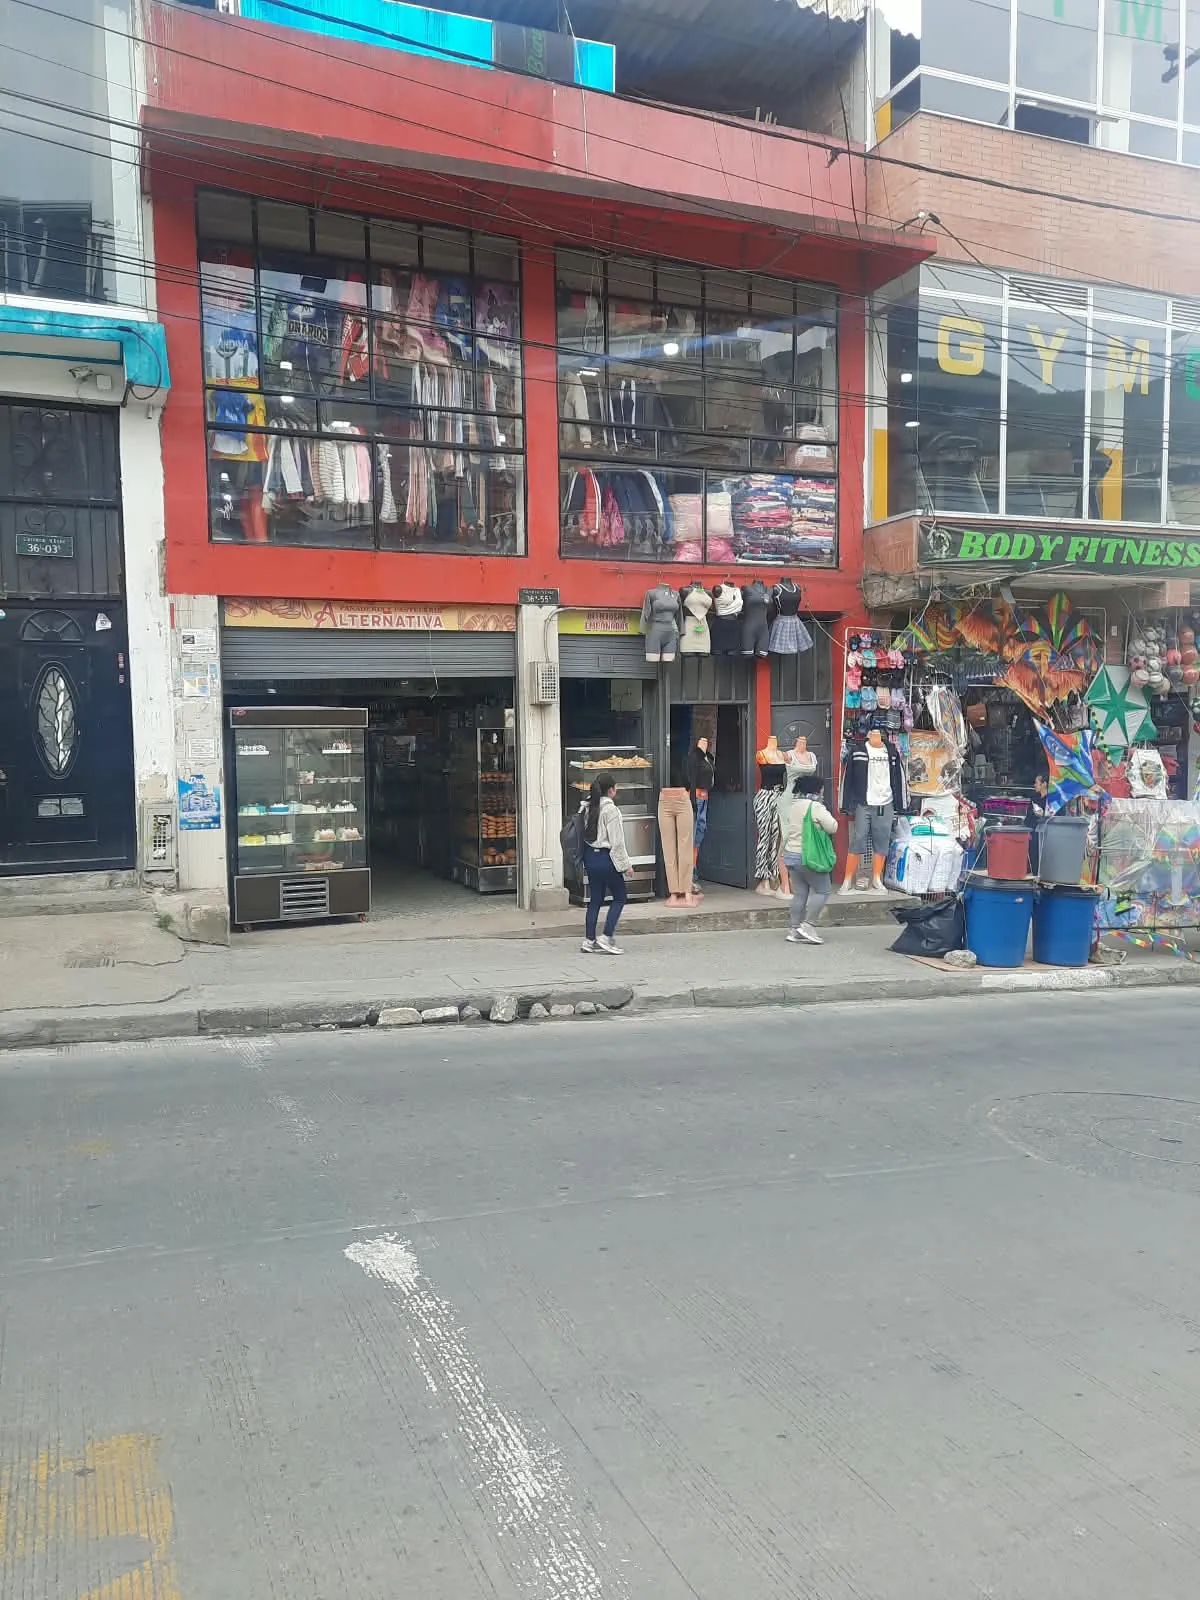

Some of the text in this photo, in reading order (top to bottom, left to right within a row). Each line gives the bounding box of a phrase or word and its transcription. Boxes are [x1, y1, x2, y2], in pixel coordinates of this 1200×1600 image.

[937, 316, 1150, 395] GYM
[958, 531, 1063, 561] BODY
[1065, 536, 1200, 567] FITNESS
[314, 600, 444, 628] ALTERNATIVA
